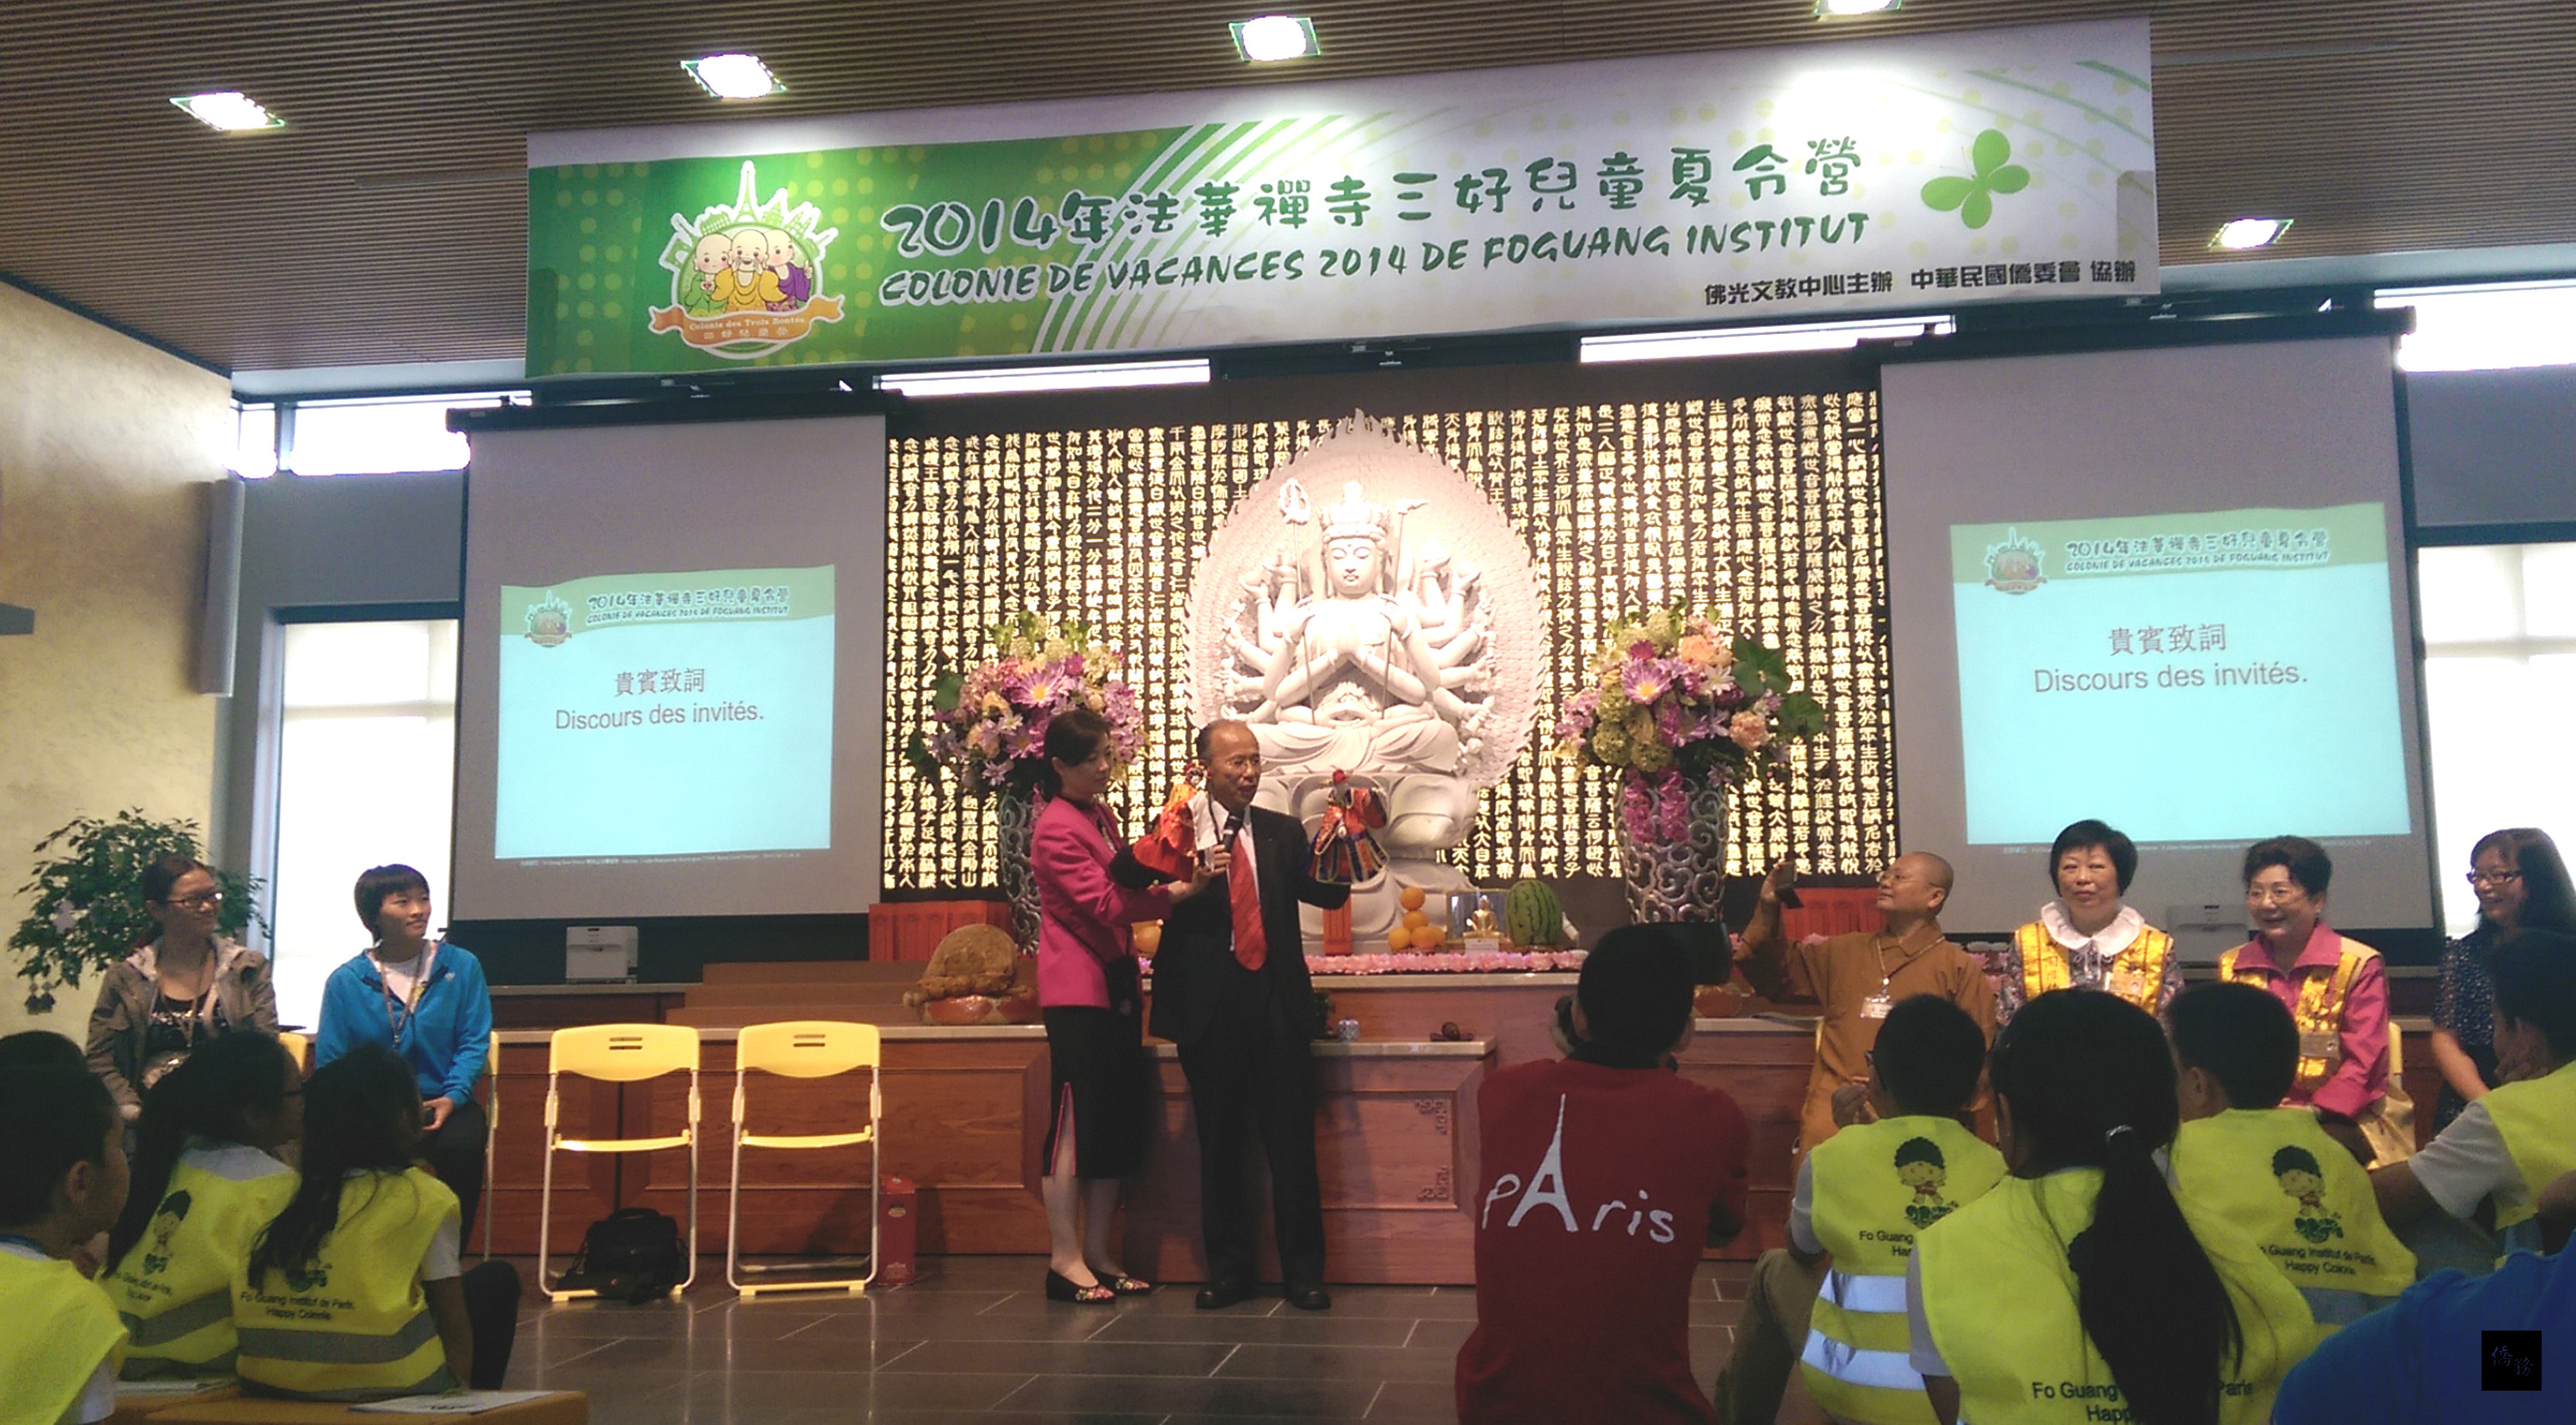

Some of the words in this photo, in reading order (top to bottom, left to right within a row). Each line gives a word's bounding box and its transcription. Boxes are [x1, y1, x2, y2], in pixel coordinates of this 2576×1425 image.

[881, 265, 1036, 303] COLONIE
[1048, 262, 1095, 294] DE
[1109, 248, 1303, 289] VACANCES
[1319, 245, 1406, 276] 2014
[1422, 240, 1469, 271] DE
[1483, 225, 1670, 269] FOGUANG
[1686, 212, 1868, 253] INSTITUT
[1704, 270, 1893, 306] 佛光文教中心主辦
[1911, 260, 2081, 290] 中華民國僑委會
[2107, 623, 2227, 657] 貴賓致詞
[614, 667, 706, 697] 貴賓致詞
[2034, 668, 2148, 694] Discours
[2157, 664, 2205, 687] des
[2214, 661, 2307, 686] invités.
[556, 707, 642, 731] Discours
[649, 704, 686, 725] des
[692, 700, 764, 723] invités.
[1858, 1230, 1874, 1240] Fo
[1876, 1229, 1914, 1245] Guang
[2032, 1381, 2056, 1399] Fo
[2060, 1381, 2118, 1402] Guang
